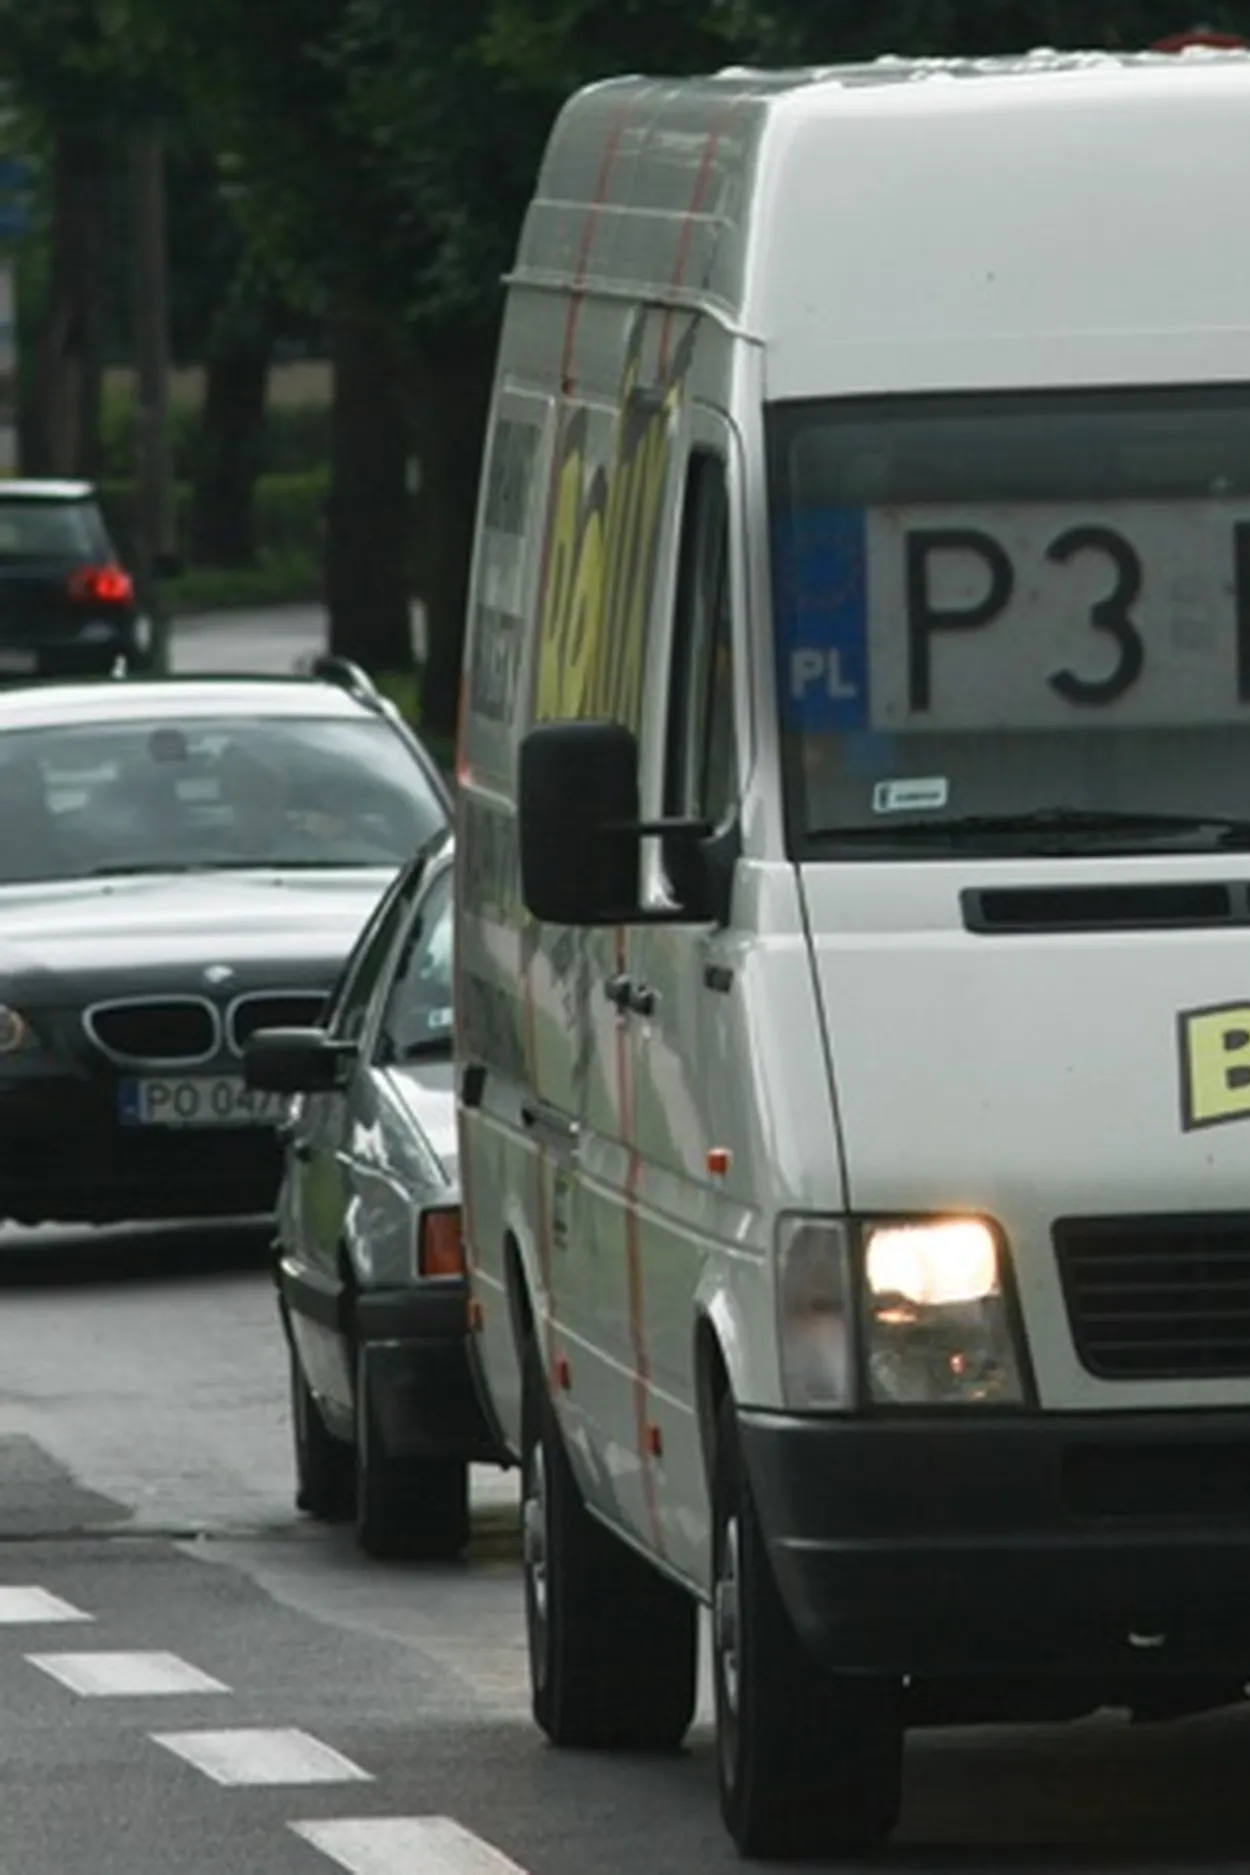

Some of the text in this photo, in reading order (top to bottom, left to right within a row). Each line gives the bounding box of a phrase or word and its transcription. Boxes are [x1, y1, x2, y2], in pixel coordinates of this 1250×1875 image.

[905, 524, 1144, 714] P3
[790, 647, 856, 699] PL
[147, 1081, 199, 1119] PO
